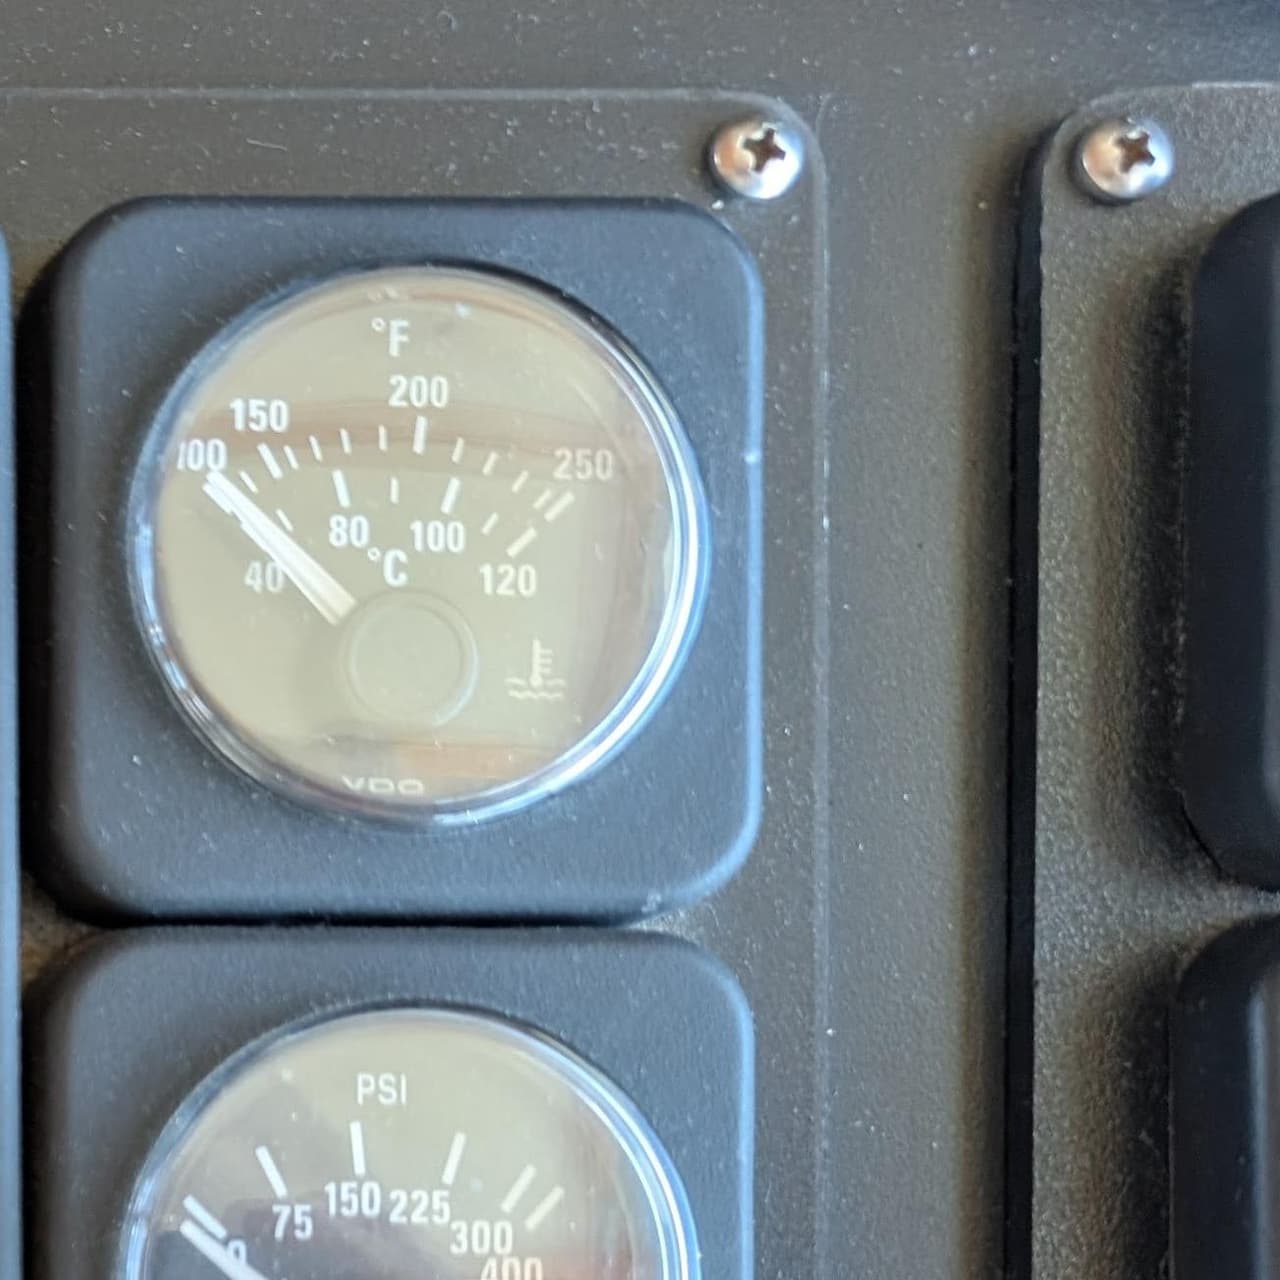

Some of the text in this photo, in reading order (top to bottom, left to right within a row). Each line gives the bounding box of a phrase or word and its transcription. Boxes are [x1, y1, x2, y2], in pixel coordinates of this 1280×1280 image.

[389, 376, 448, 408] 200
[230, 398, 288, 432] 150
[554, 448, 613, 481] 250
[329, 515, 368, 548] 80
[410, 521, 465, 553] 100
[244, 560, 284, 593] 40
[480, 565, 536, 597] 120
[341, 774, 424, 795] VDO
[357, 1073, 407, 1104] PSI
[324, 1181, 381, 1218] 150
[389, 1190, 451, 1225] 225
[272, 1204, 313, 1241] 75
[450, 1220, 513, 1255] 300
